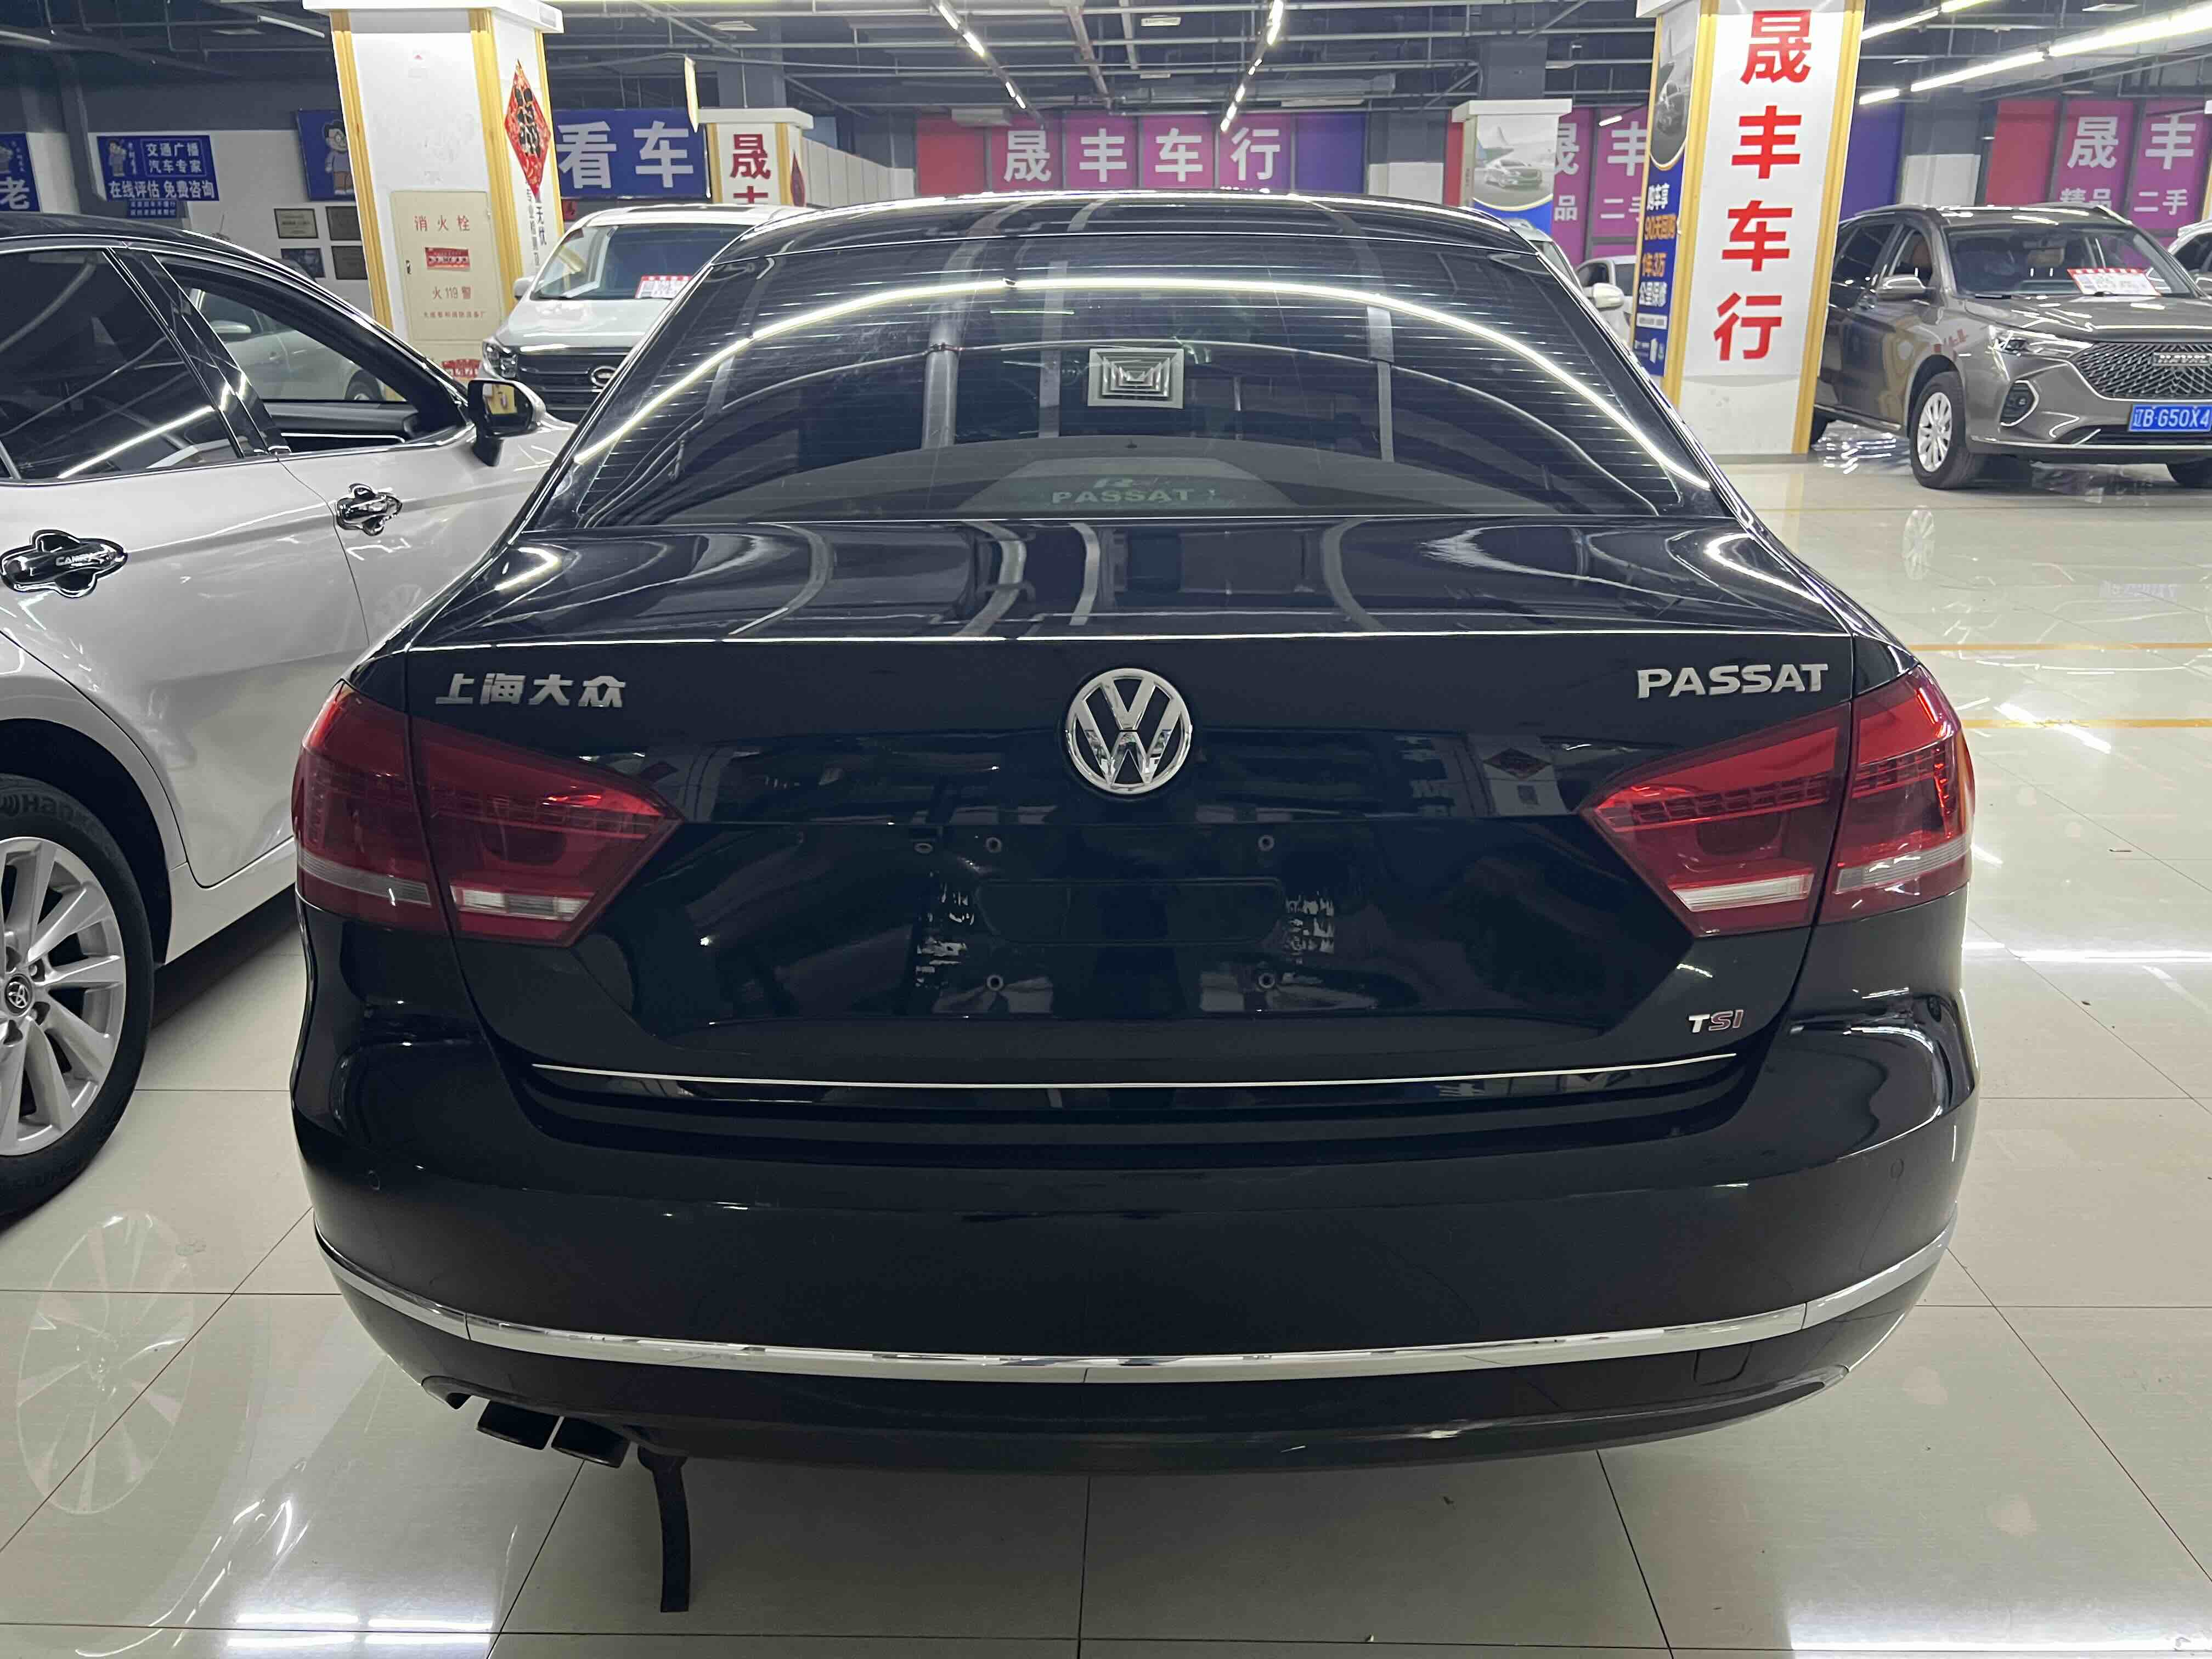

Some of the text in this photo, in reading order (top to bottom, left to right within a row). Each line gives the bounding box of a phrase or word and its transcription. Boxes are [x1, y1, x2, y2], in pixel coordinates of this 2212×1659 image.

[146, 142, 199, 157] 交通广播
[556, 120, 693, 189] 看车
[1004, 128, 1280, 183] 晟丰车行
[2067, 116, 2196, 170] 晟丰
[149, 159, 202, 173] 汽车专家
[0, 176, 30, 210] 老
[109, 179, 215, 199] 在线评估 免费咨询
[1714, 10, 1812, 361] 晟丰车行
[2134, 189, 2189, 216] 二手
[414, 215, 470, 232] 消火栓
[1052, 488, 1194, 504] PASSAT
[435, 673, 627, 708] 上海大众
[1637, 663, 1829, 699] PASSAT
[1689, 1009, 1744, 1032] TSI
